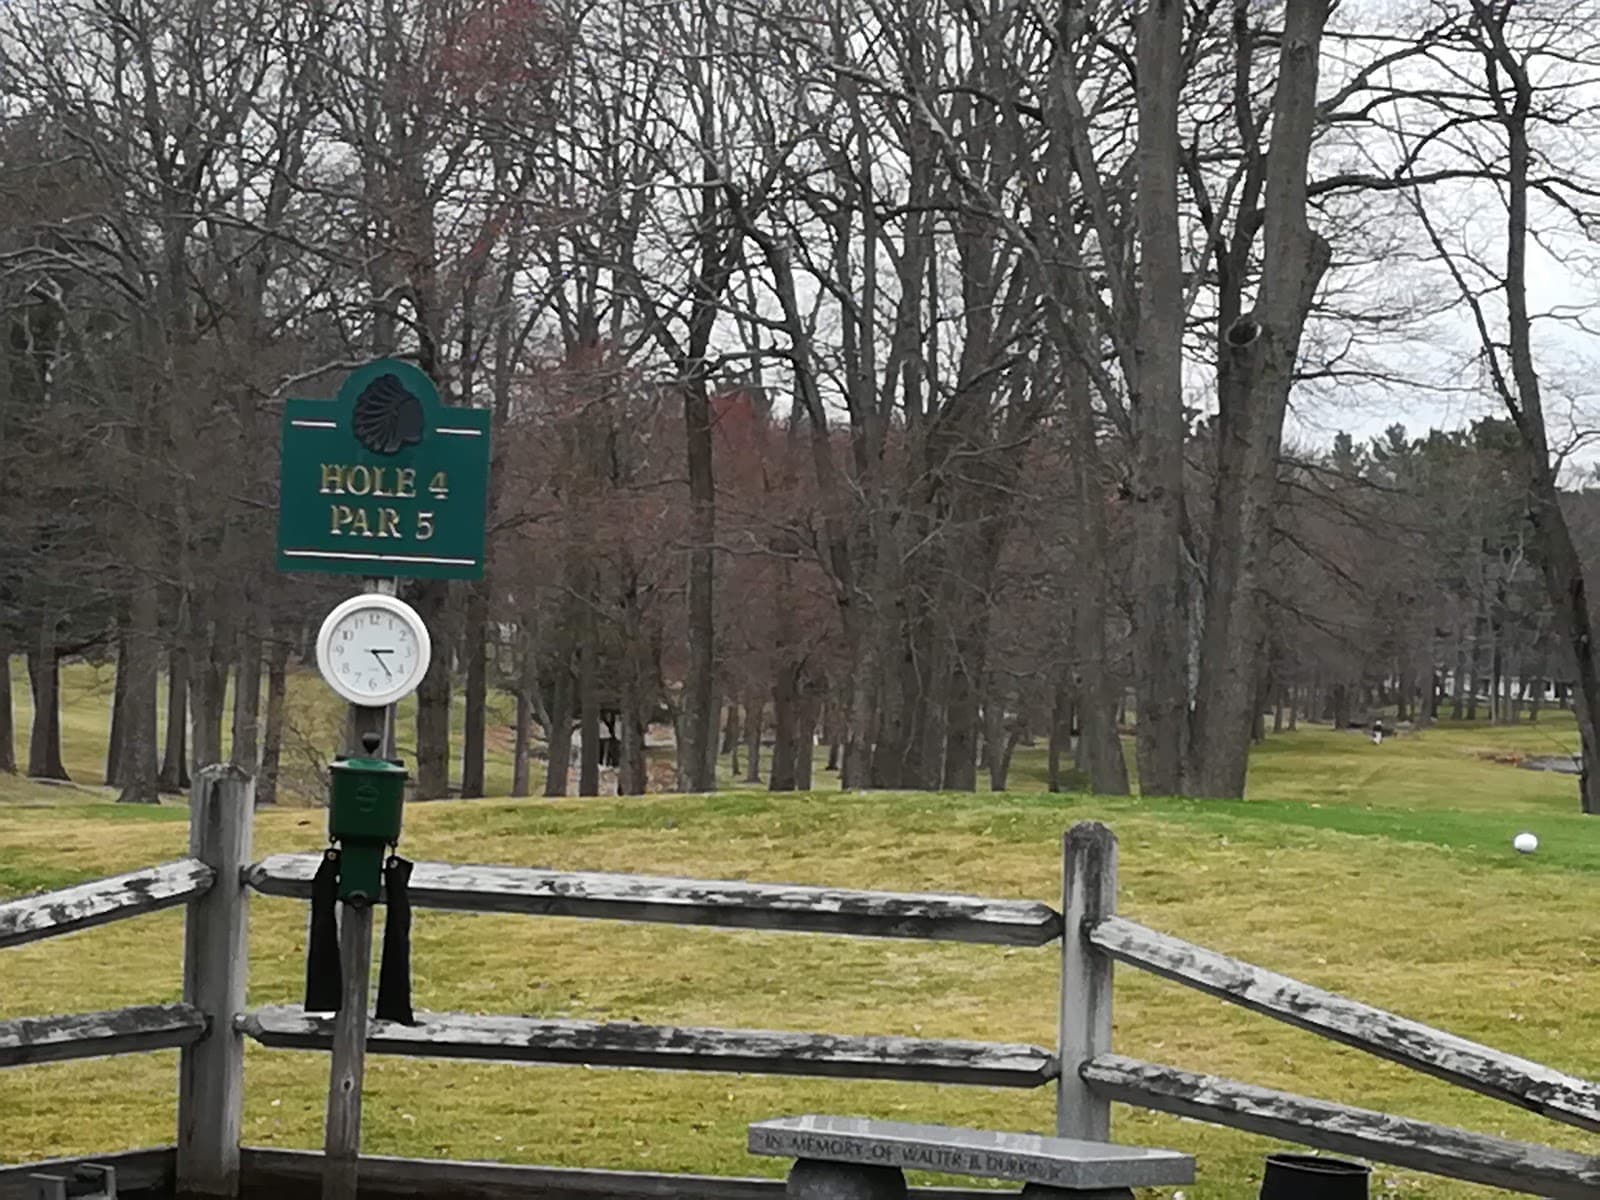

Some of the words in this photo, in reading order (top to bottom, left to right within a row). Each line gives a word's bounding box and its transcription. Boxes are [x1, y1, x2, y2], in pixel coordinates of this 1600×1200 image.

[320, 463, 417, 498] HOLE
[428, 471, 449, 500] 4
[329, 504, 403, 538] PAR
[416, 511, 435, 540] 5
[354, 618, 365, 630] 11
[369, 613, 381, 626] 12
[343, 630, 354, 641] 10
[399, 630, 407, 641] 2
[336, 645, 345, 656] 9
[342, 662, 350, 674] 8
[397, 663, 404, 674] 4
[354, 672, 362, 683] 7
[369, 678, 378, 691] 6
[764, 1133, 781, 1148] IN
[791, 1136, 864, 1156] MEMORY
[872, 1144, 894, 1162] OF
[901, 1146, 961, 1168] WALTER
